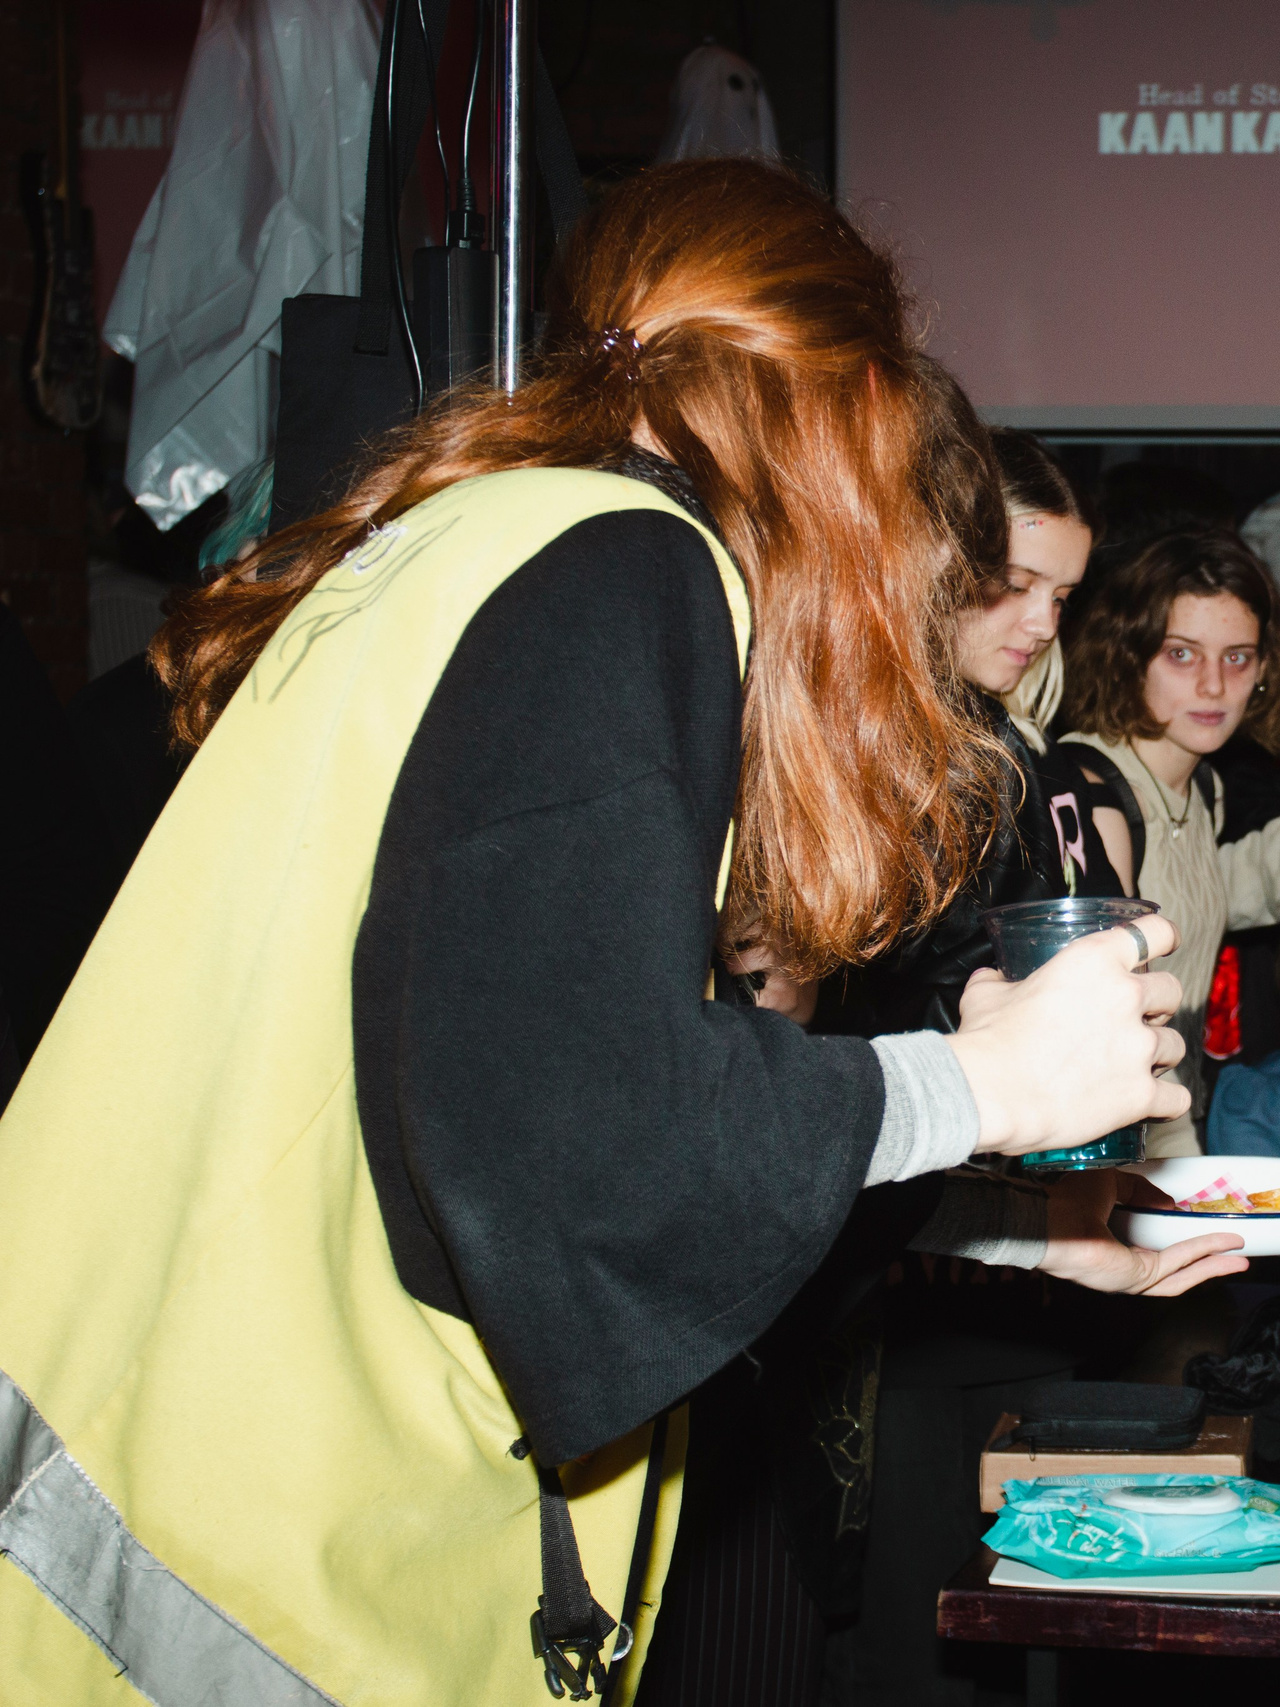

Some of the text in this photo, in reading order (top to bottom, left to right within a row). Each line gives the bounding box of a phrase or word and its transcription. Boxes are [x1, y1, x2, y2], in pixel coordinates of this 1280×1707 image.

[1138, 83, 1203, 106] Head
[1213, 83, 1240, 106] of
[80, 114, 162, 149] KAAN
[1099, 111, 1224, 153] KAAN
